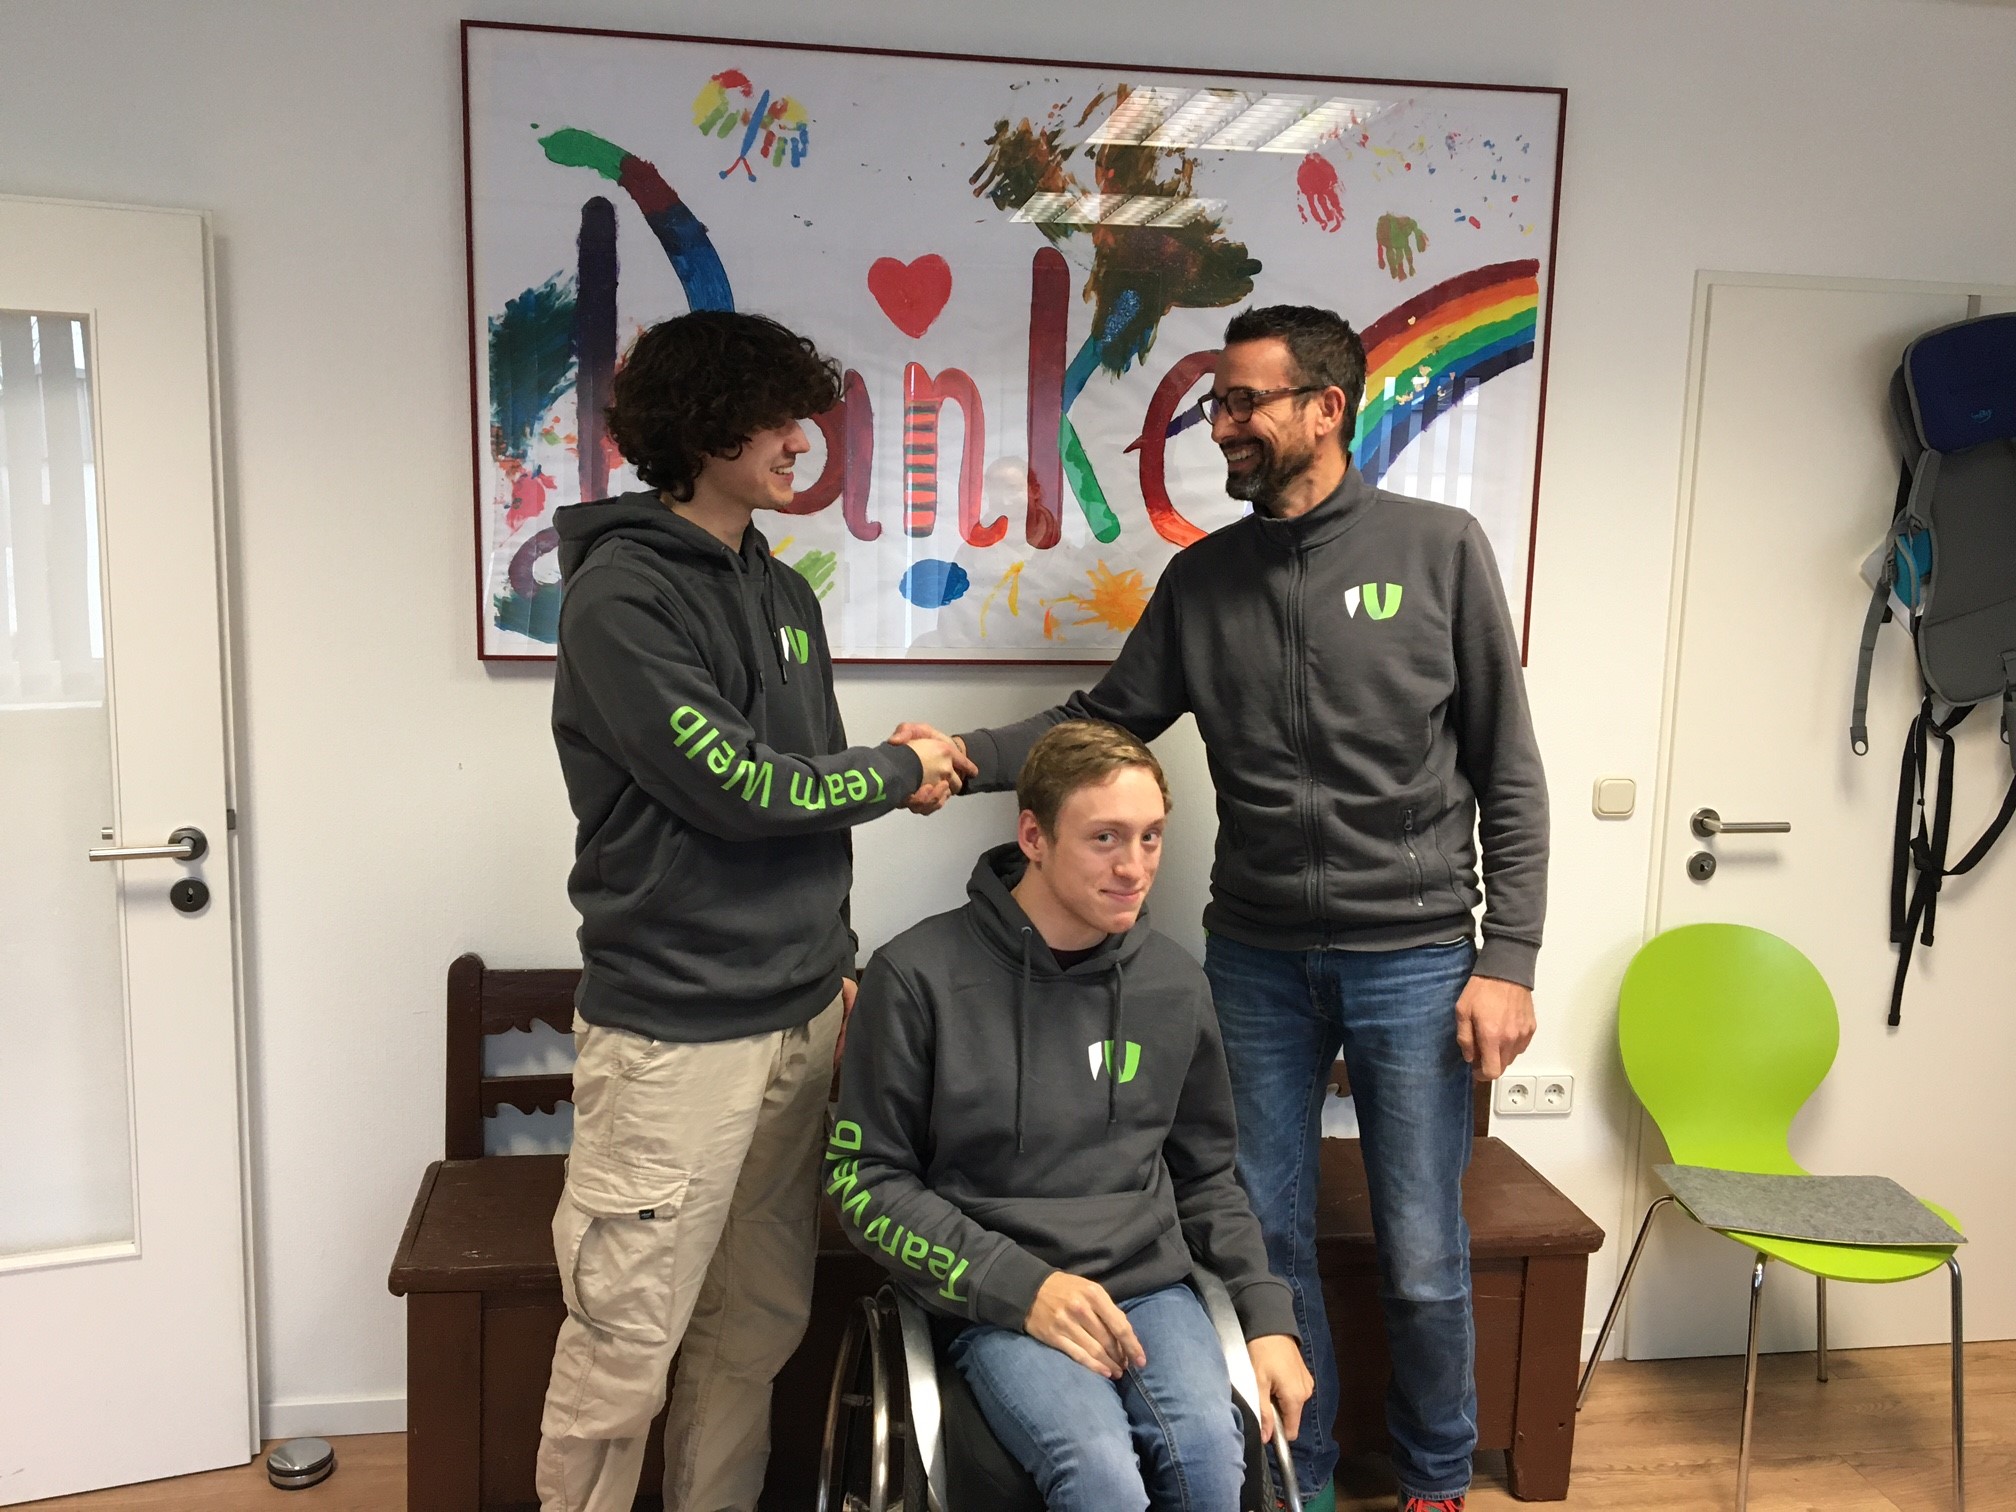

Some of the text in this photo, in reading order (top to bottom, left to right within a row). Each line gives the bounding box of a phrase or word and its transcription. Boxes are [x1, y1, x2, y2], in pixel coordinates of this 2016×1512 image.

[669, 705, 887, 811] Team Welb
[863, 1214, 970, 1302] Team
